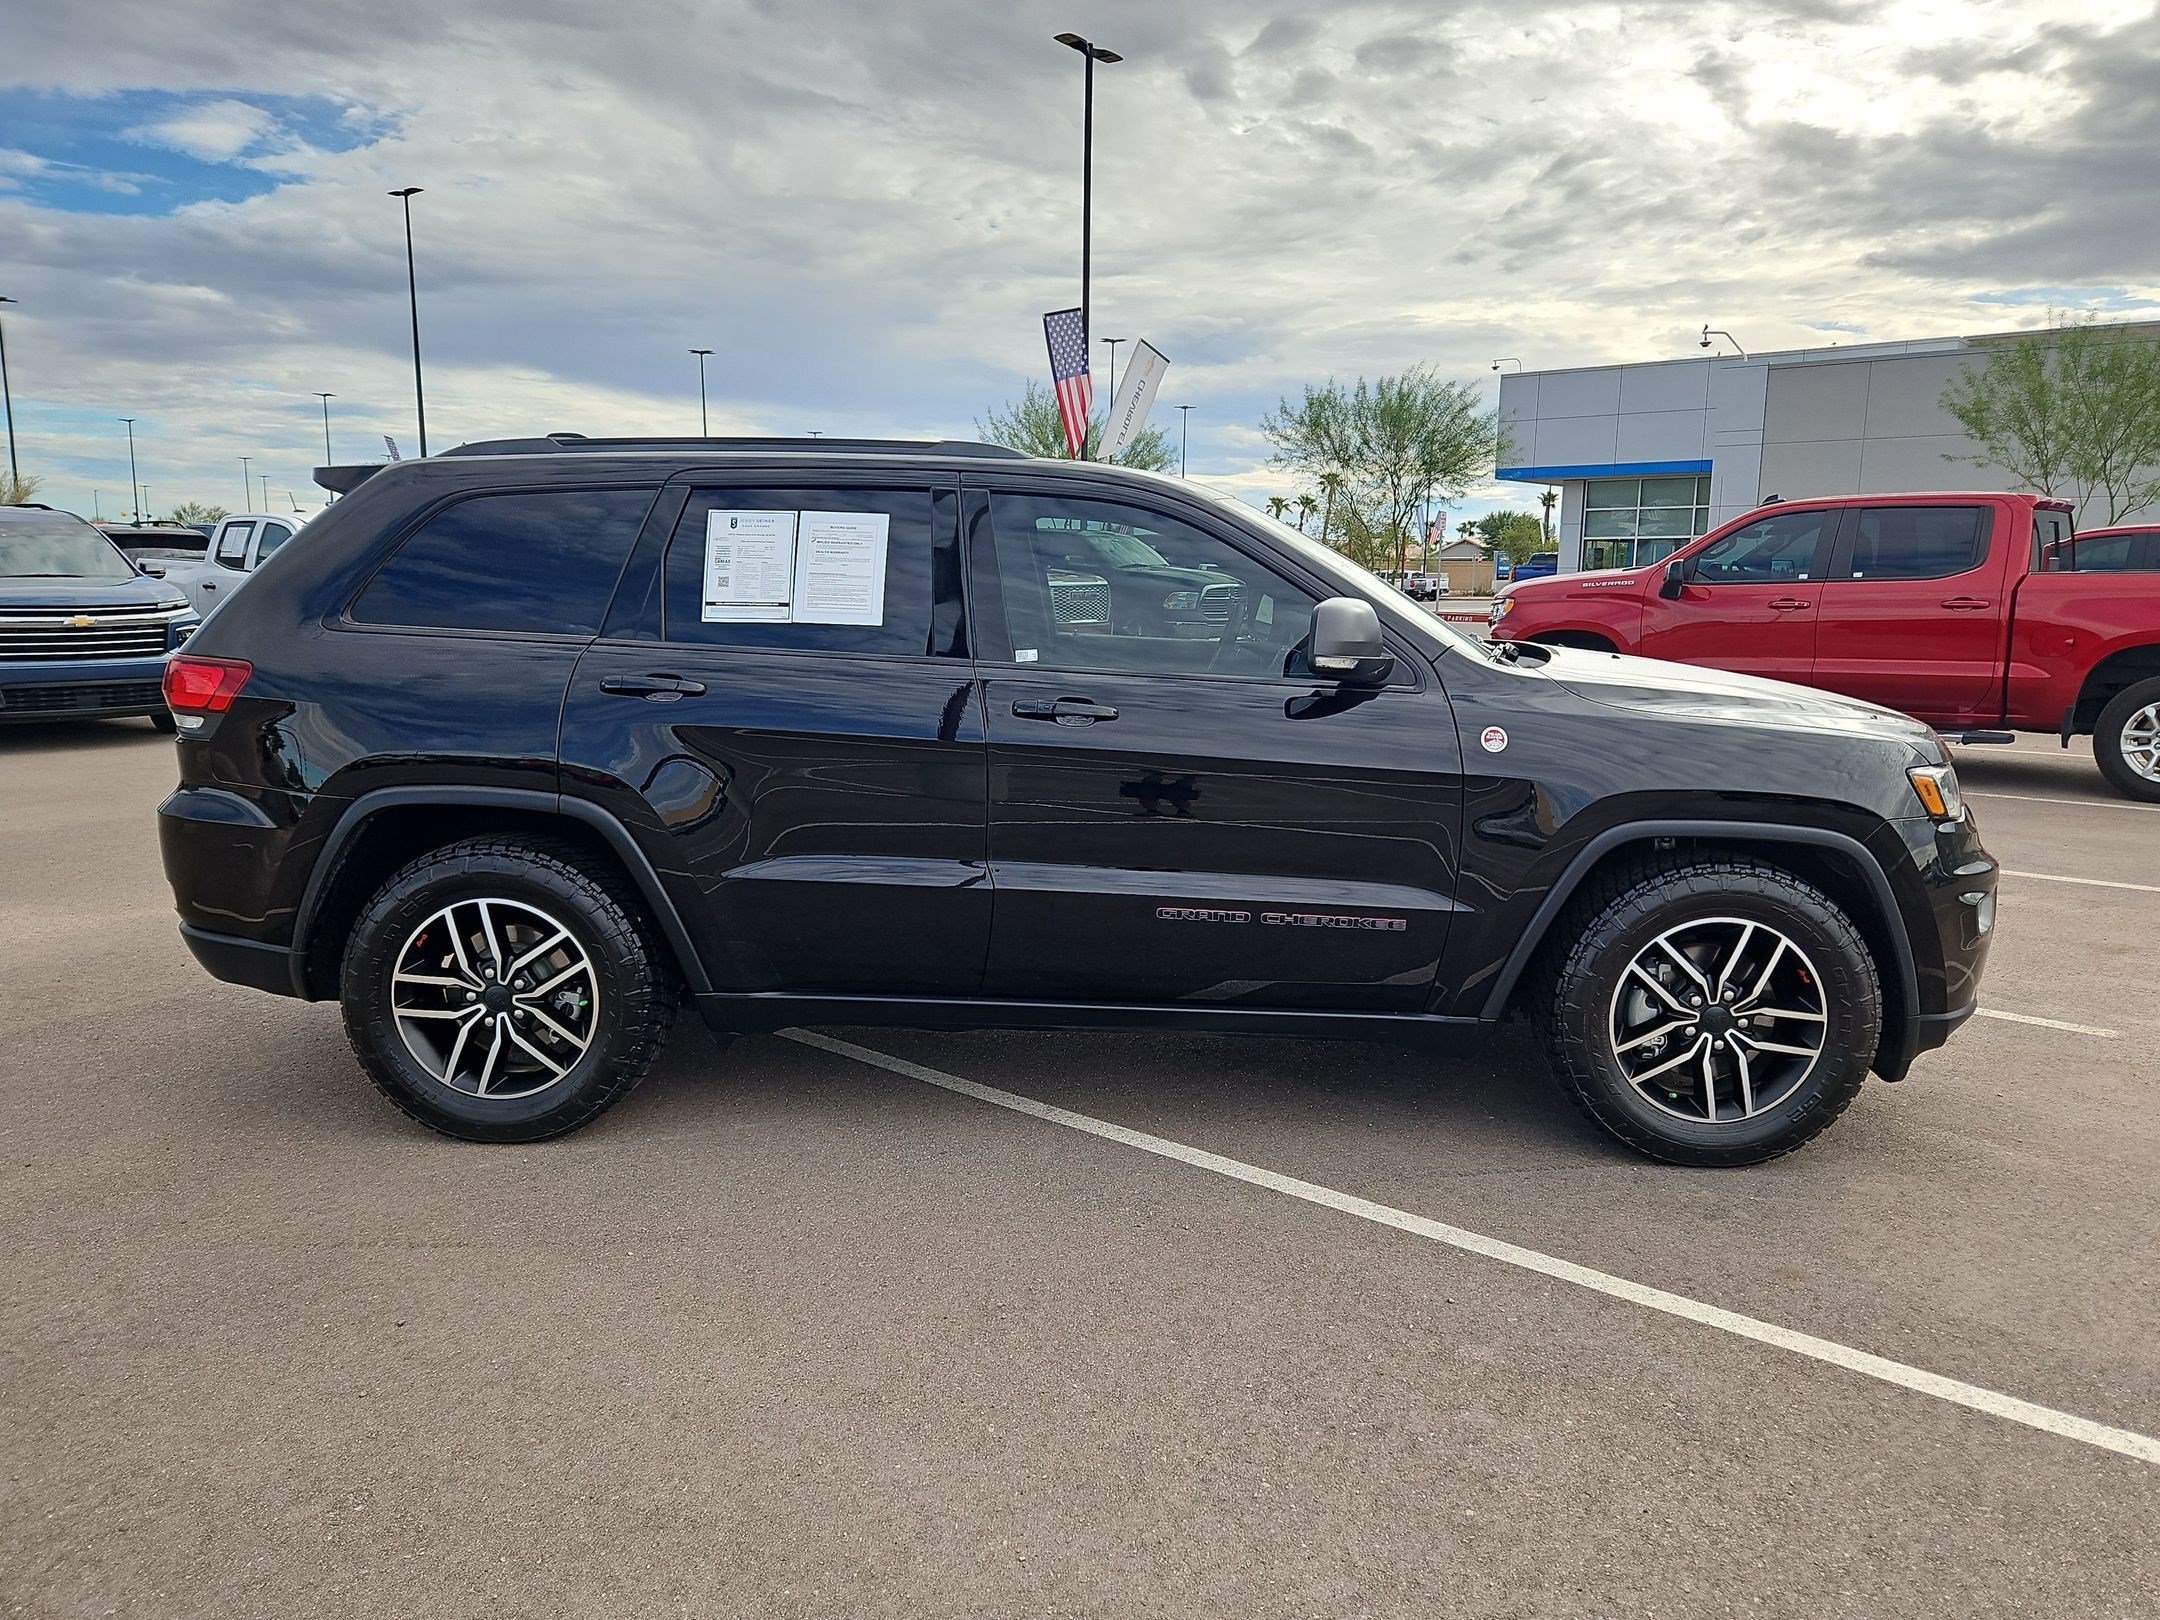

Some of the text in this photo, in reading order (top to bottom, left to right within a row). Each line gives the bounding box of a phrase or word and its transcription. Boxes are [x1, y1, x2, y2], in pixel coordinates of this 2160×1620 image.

[1582, 580, 1635, 588] SILVERADO
[1156, 907, 1407, 931] GRAND CHEROKEE
